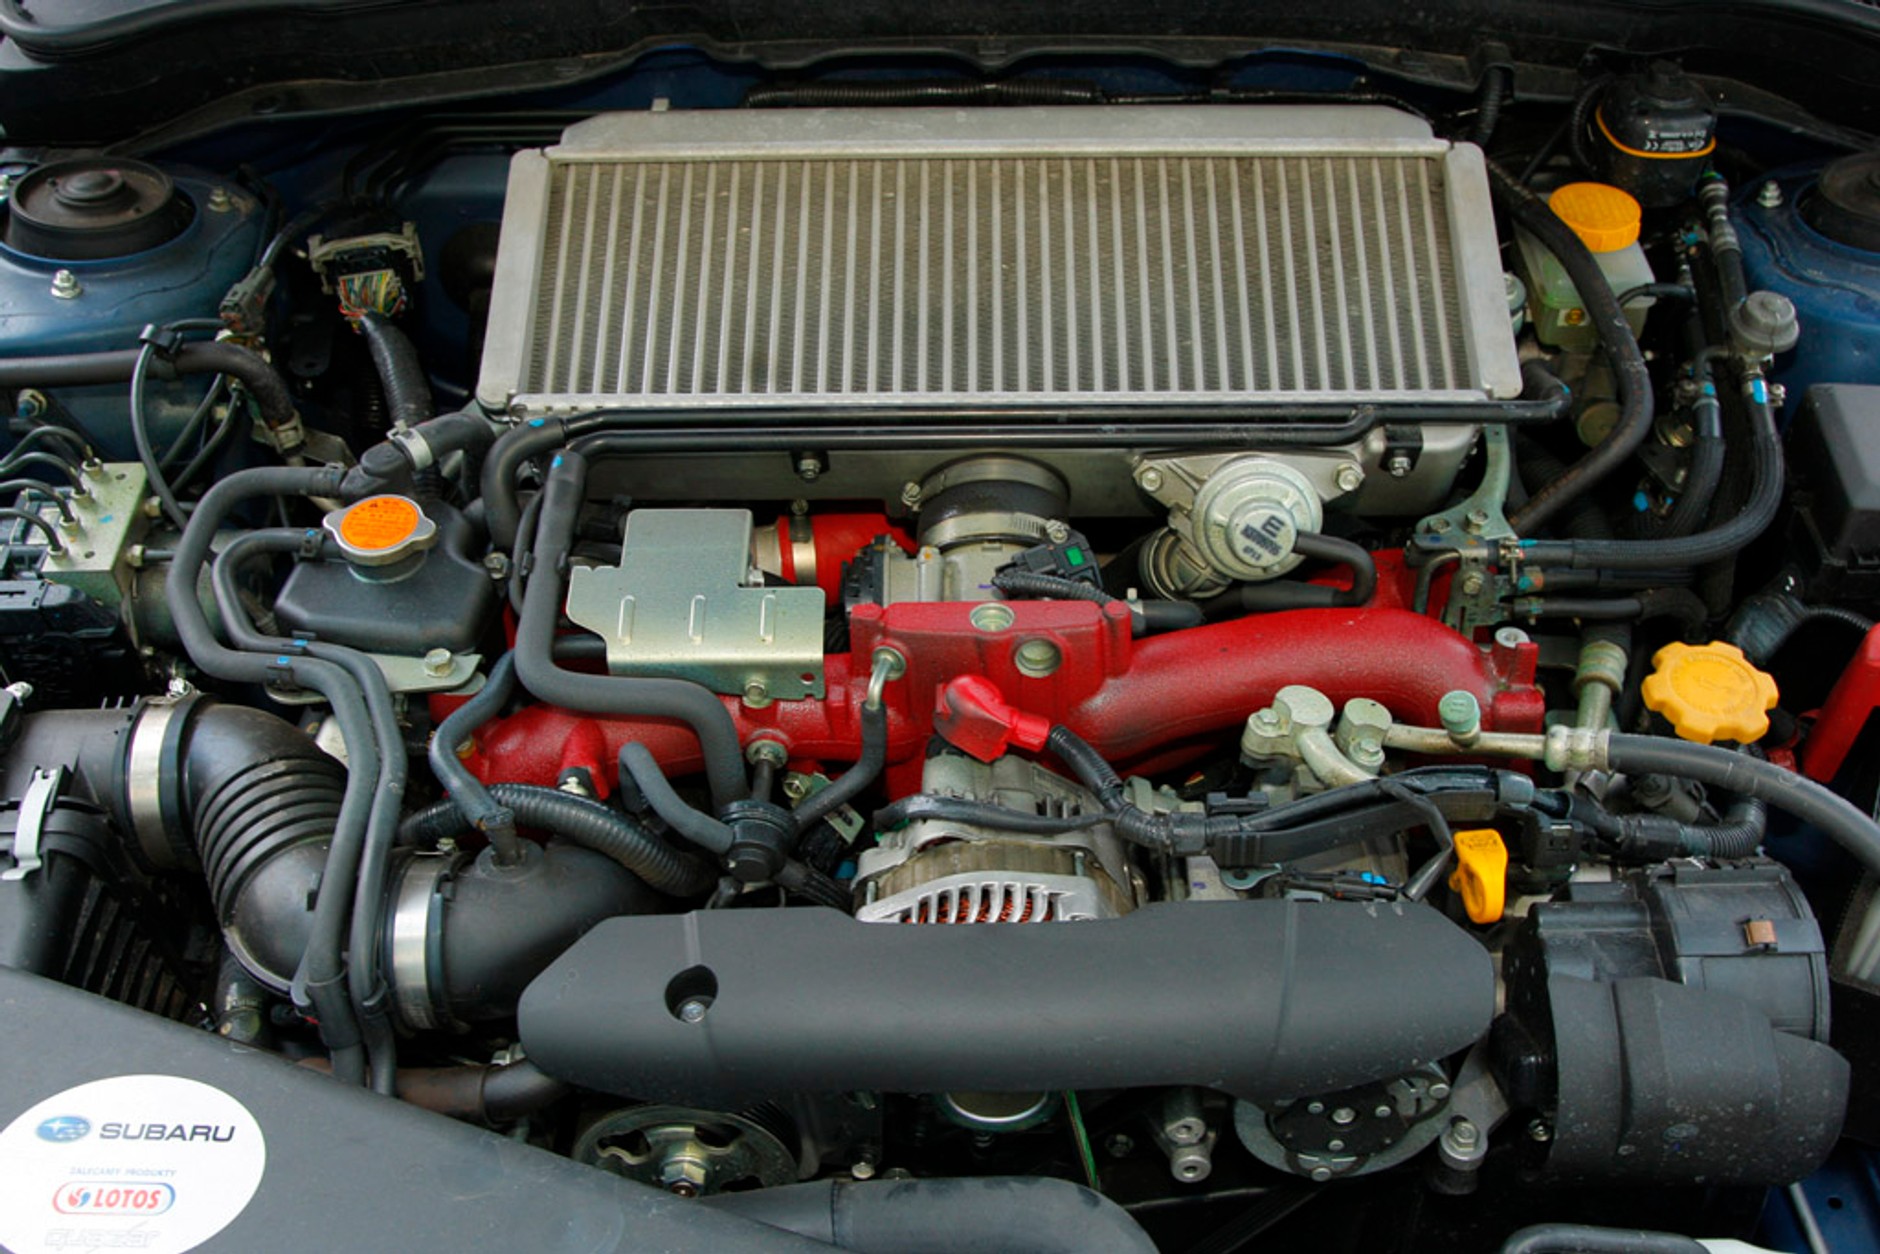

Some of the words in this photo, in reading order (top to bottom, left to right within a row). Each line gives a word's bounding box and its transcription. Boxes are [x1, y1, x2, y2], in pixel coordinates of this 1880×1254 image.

[99, 1122, 235, 1142] SUBARU
[124, 1168, 177, 1178] PRODUKTY
[93, 1188, 161, 1210] LOTOS
